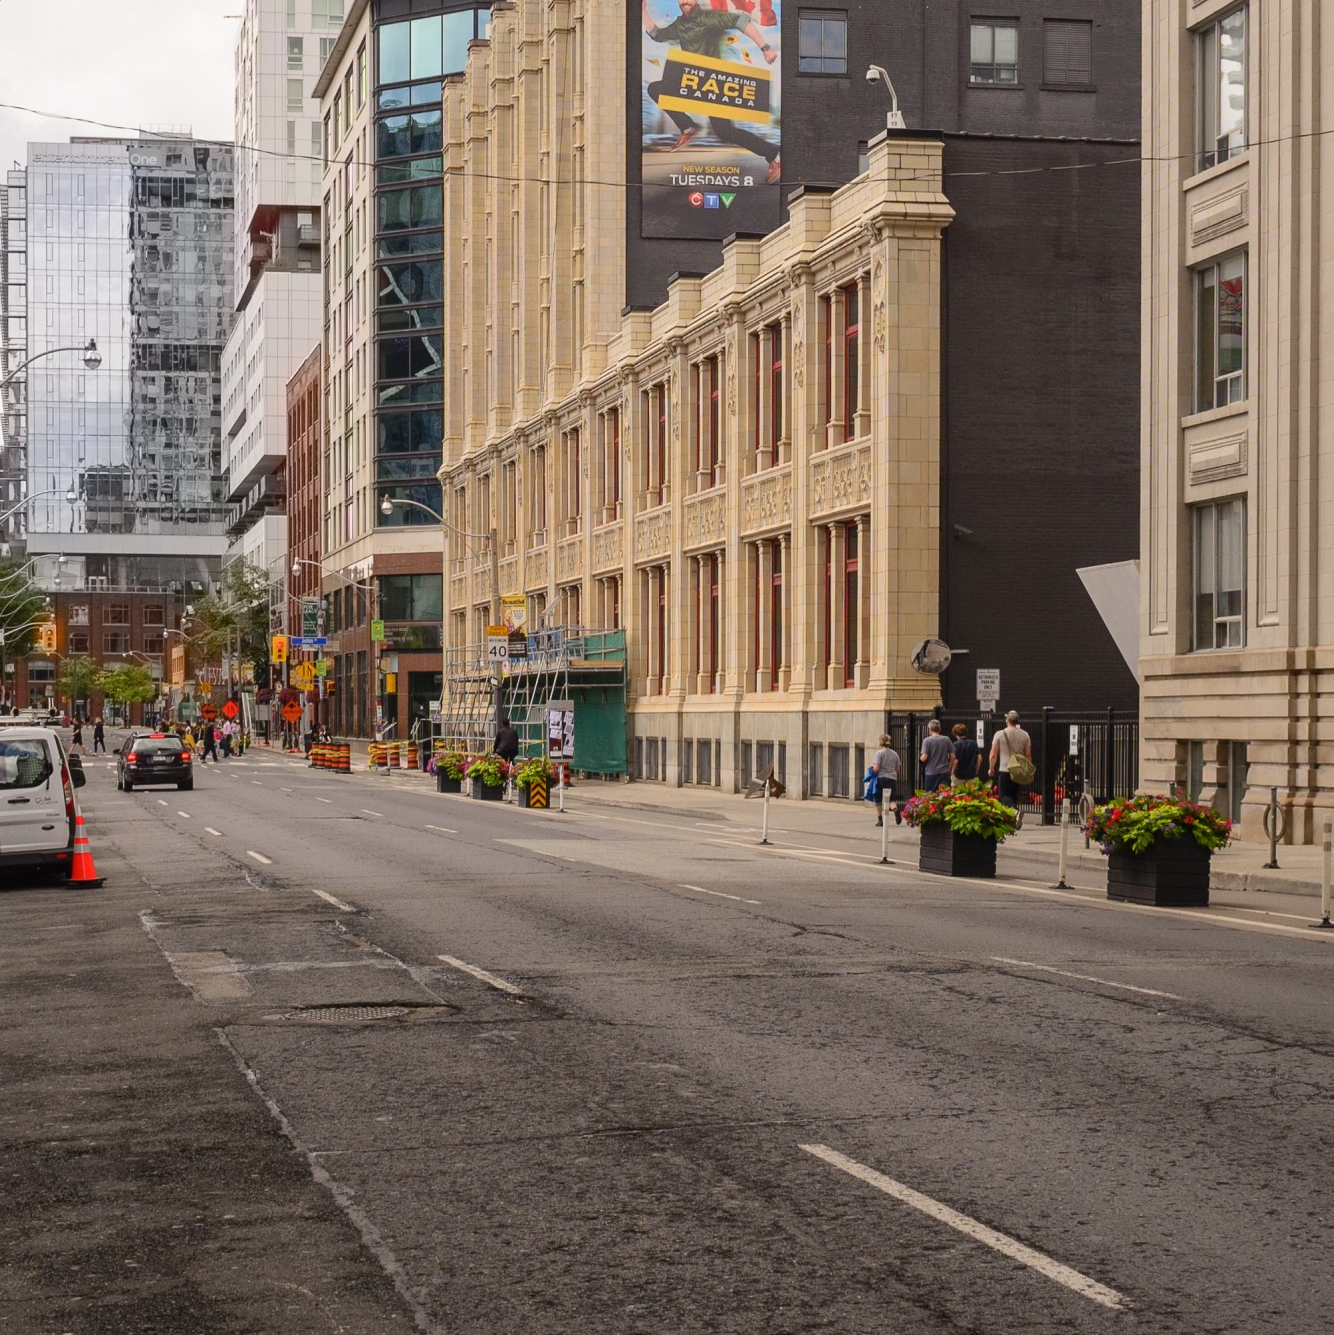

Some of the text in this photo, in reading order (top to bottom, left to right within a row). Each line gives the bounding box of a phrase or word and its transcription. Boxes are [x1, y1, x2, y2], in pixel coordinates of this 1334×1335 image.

[683, 67, 757, 87] THE AMAZING
[680, 73, 756, 100] RACE
[679, 88, 755, 107] CANADA
[130, 153, 158, 165] One
[682, 165, 740, 174] NEW SEASON
[669, 174, 754, 187] TUESDAYS 8
[689, 192, 736, 208] CTV
[489, 646, 507, 657] 40
